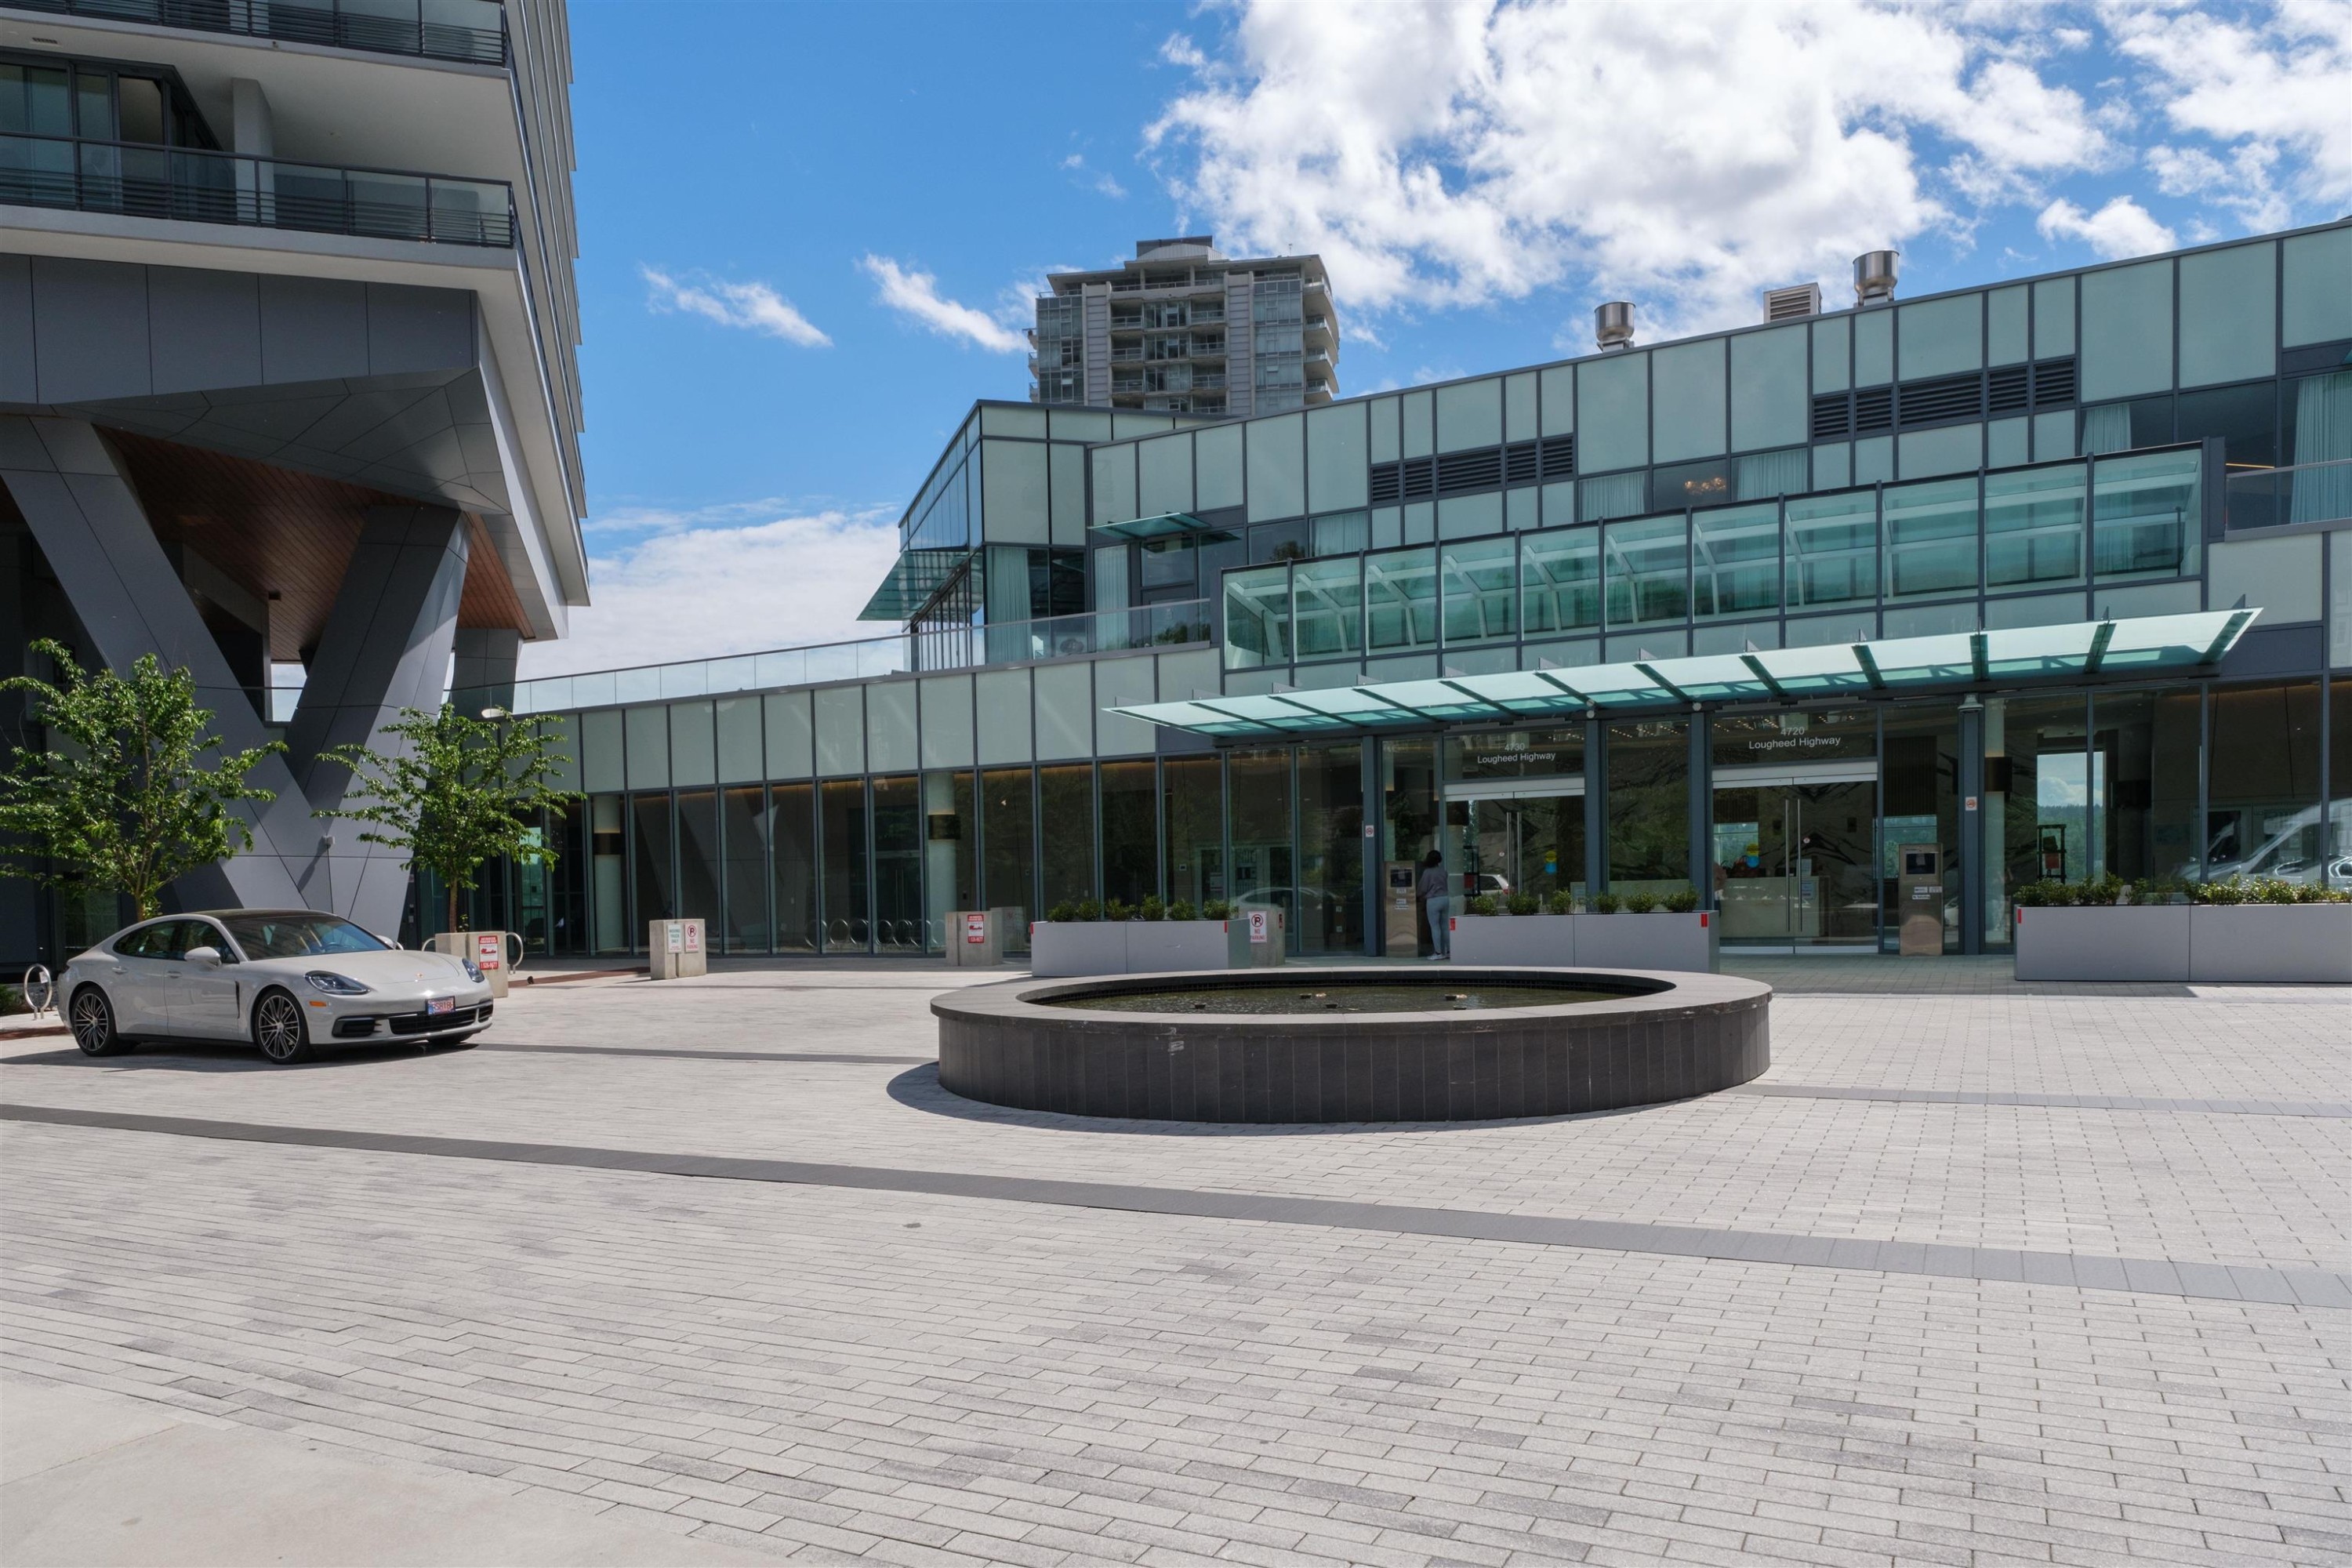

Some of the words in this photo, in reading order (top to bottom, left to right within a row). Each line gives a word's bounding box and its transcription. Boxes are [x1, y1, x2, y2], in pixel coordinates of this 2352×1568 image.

[1780, 727, 1805, 736] 4720
[1504, 742, 1526, 751] 4730
[1748, 739, 1796, 750] Lougheed
[1799, 737, 1841, 747] Highway
[1477, 753, 1518, 764] Lougheed
[1519, 753, 1556, 762] Highway
